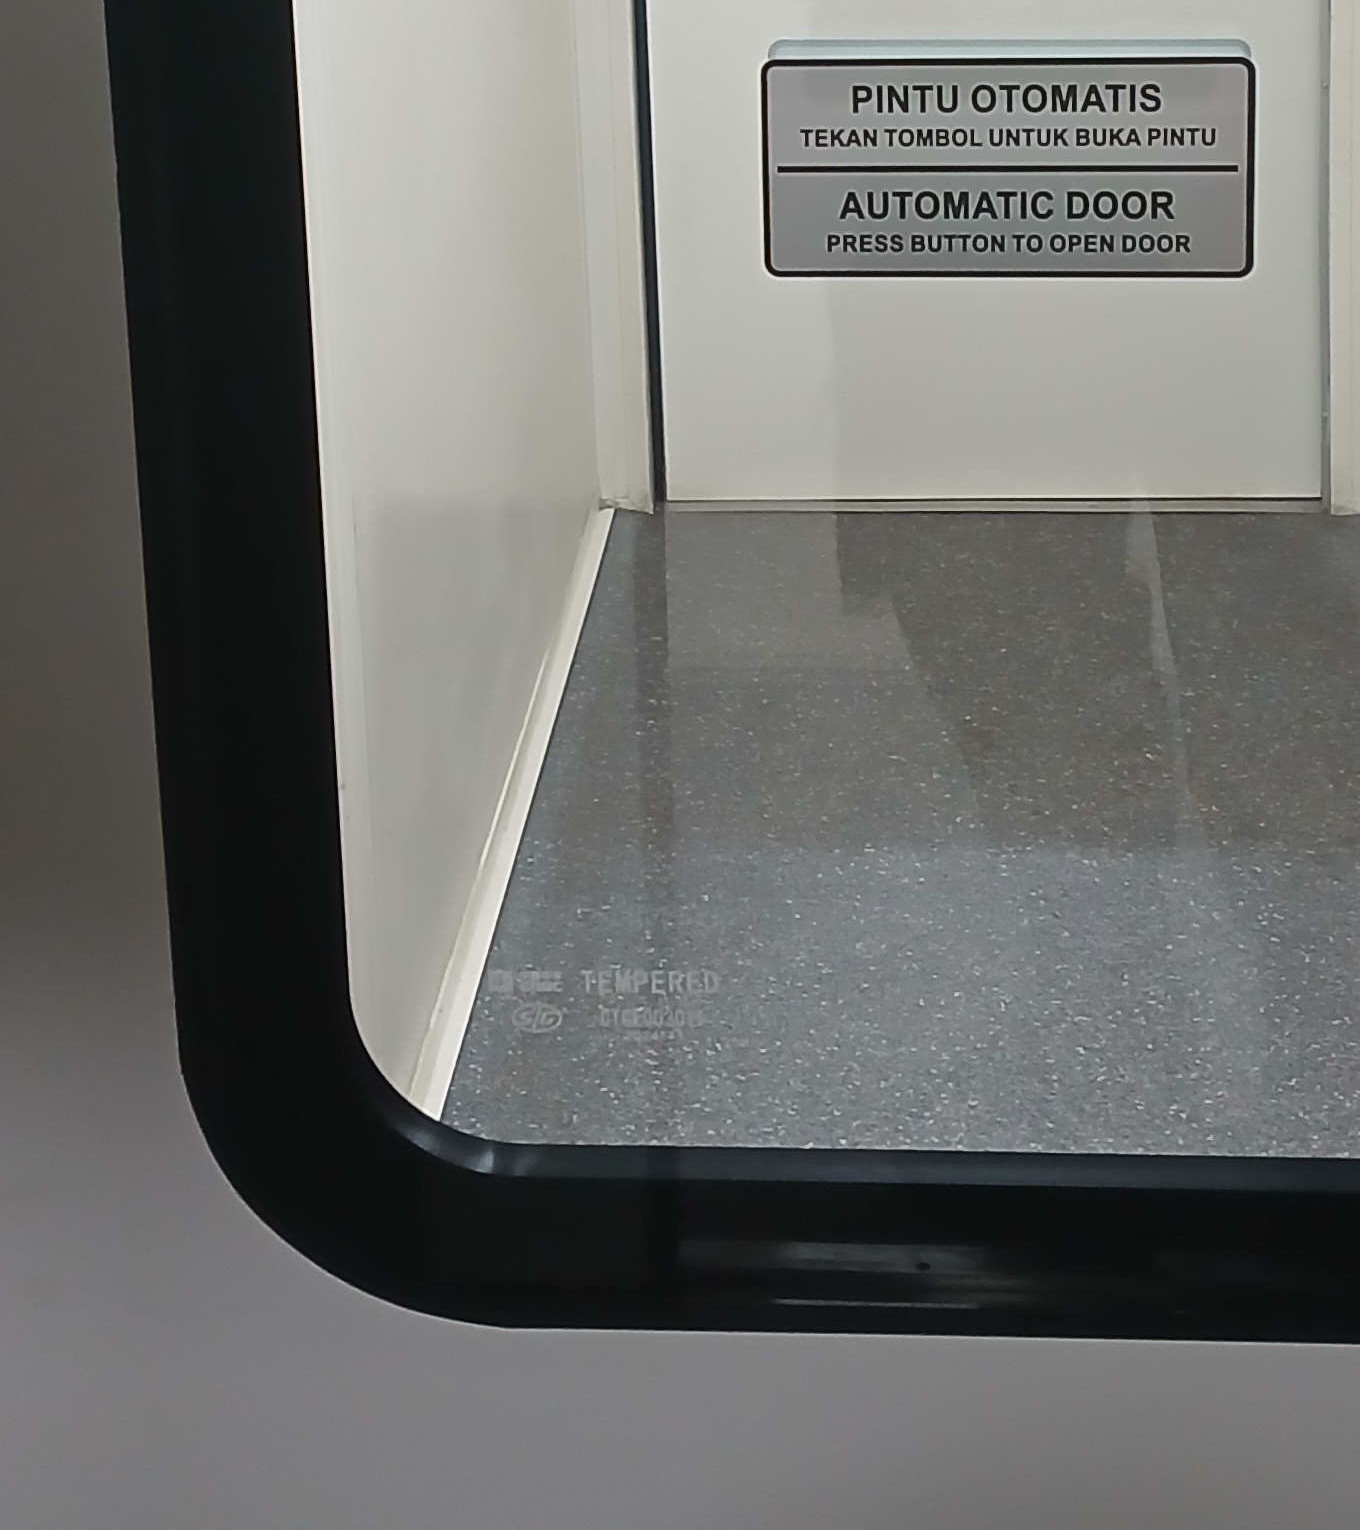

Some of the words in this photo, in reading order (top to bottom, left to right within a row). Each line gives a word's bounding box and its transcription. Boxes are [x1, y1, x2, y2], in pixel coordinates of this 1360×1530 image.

[852, 84, 960, 114] PINTU
[971, 83, 1162, 113] OTOMATIS
[799, 128, 878, 148] TEKAN
[883, 128, 983, 148] TOMBOL
[988, 128, 1069, 147] UNTUK
[1075, 127, 1142, 147] BUKA
[1147, 127, 1217, 147] PINTU
[839, 190, 1054, 220] AUTOMATIC
[1066, 190, 1175, 220] DOOR
[827, 233, 904, 253] PRESS
[910, 233, 1006, 253] BUTTON
[1011, 234, 1044, 254] TO
[1049, 234, 1115, 254] OPEN
[1121, 234, 1191, 254] DOOR
[580, 969, 721, 994] TEMPERED
